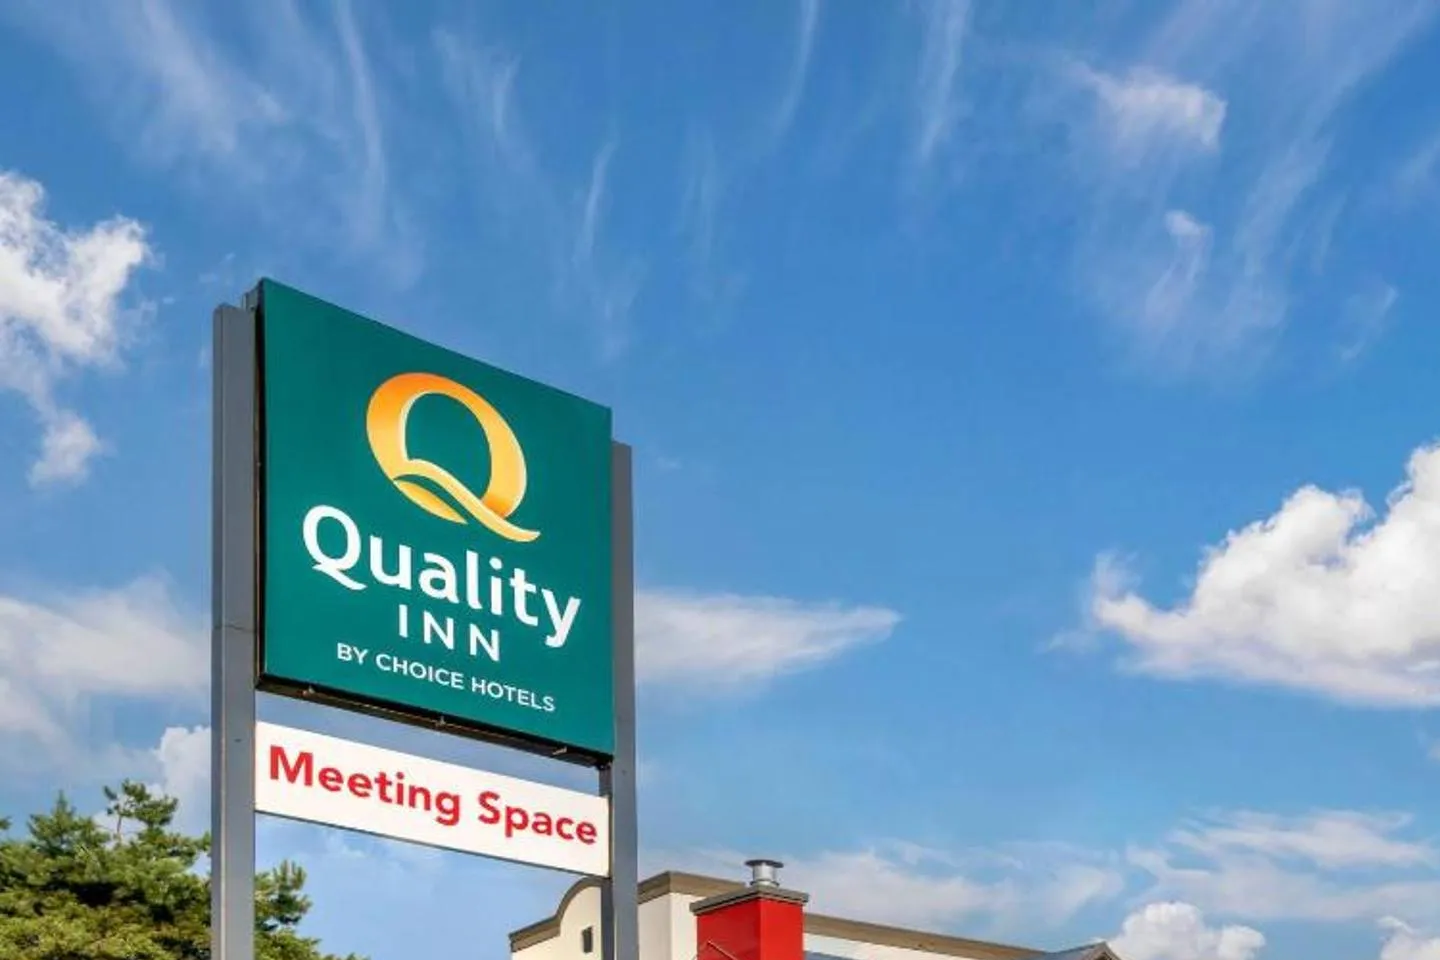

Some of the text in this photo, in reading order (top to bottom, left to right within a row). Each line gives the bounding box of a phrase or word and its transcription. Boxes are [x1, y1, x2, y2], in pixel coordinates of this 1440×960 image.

[366, 372, 541, 542] Q
[302, 504, 581, 647] Quality
[337, 642, 556, 713] BY CHOICE HOTELS
[398, 604, 500, 662] INN
[268, 745, 598, 844] Meeting Space
